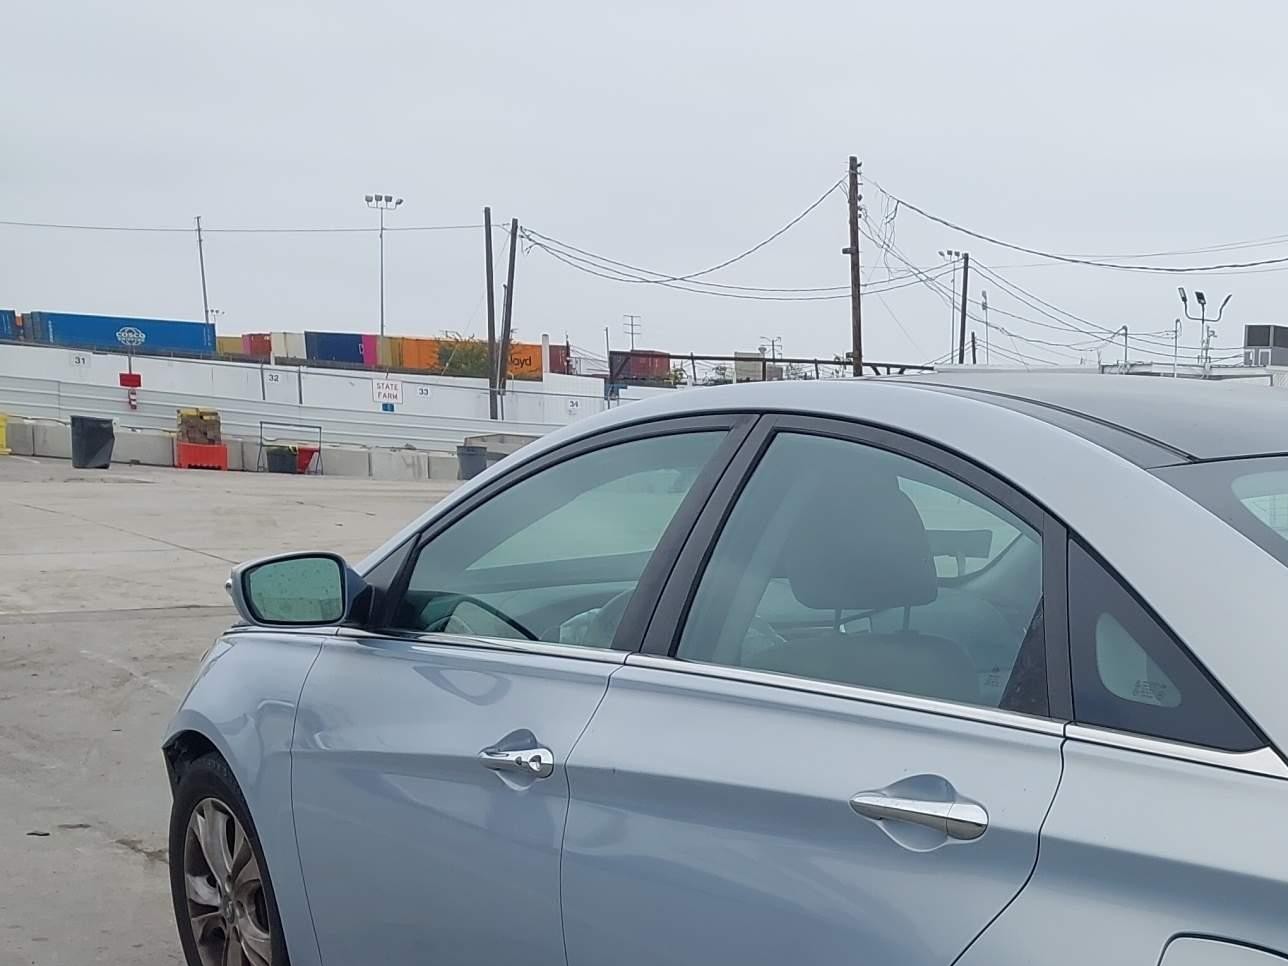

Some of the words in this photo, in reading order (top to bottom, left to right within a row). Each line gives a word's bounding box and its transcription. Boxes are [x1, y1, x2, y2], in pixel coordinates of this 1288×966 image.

[74, 357, 86, 365] 31
[510, 355, 532, 368] loyd
[268, 374, 279, 382] 32
[376, 382, 399, 391] STATE
[377, 391, 398, 400] FARM
[418, 388, 429, 396] 33
